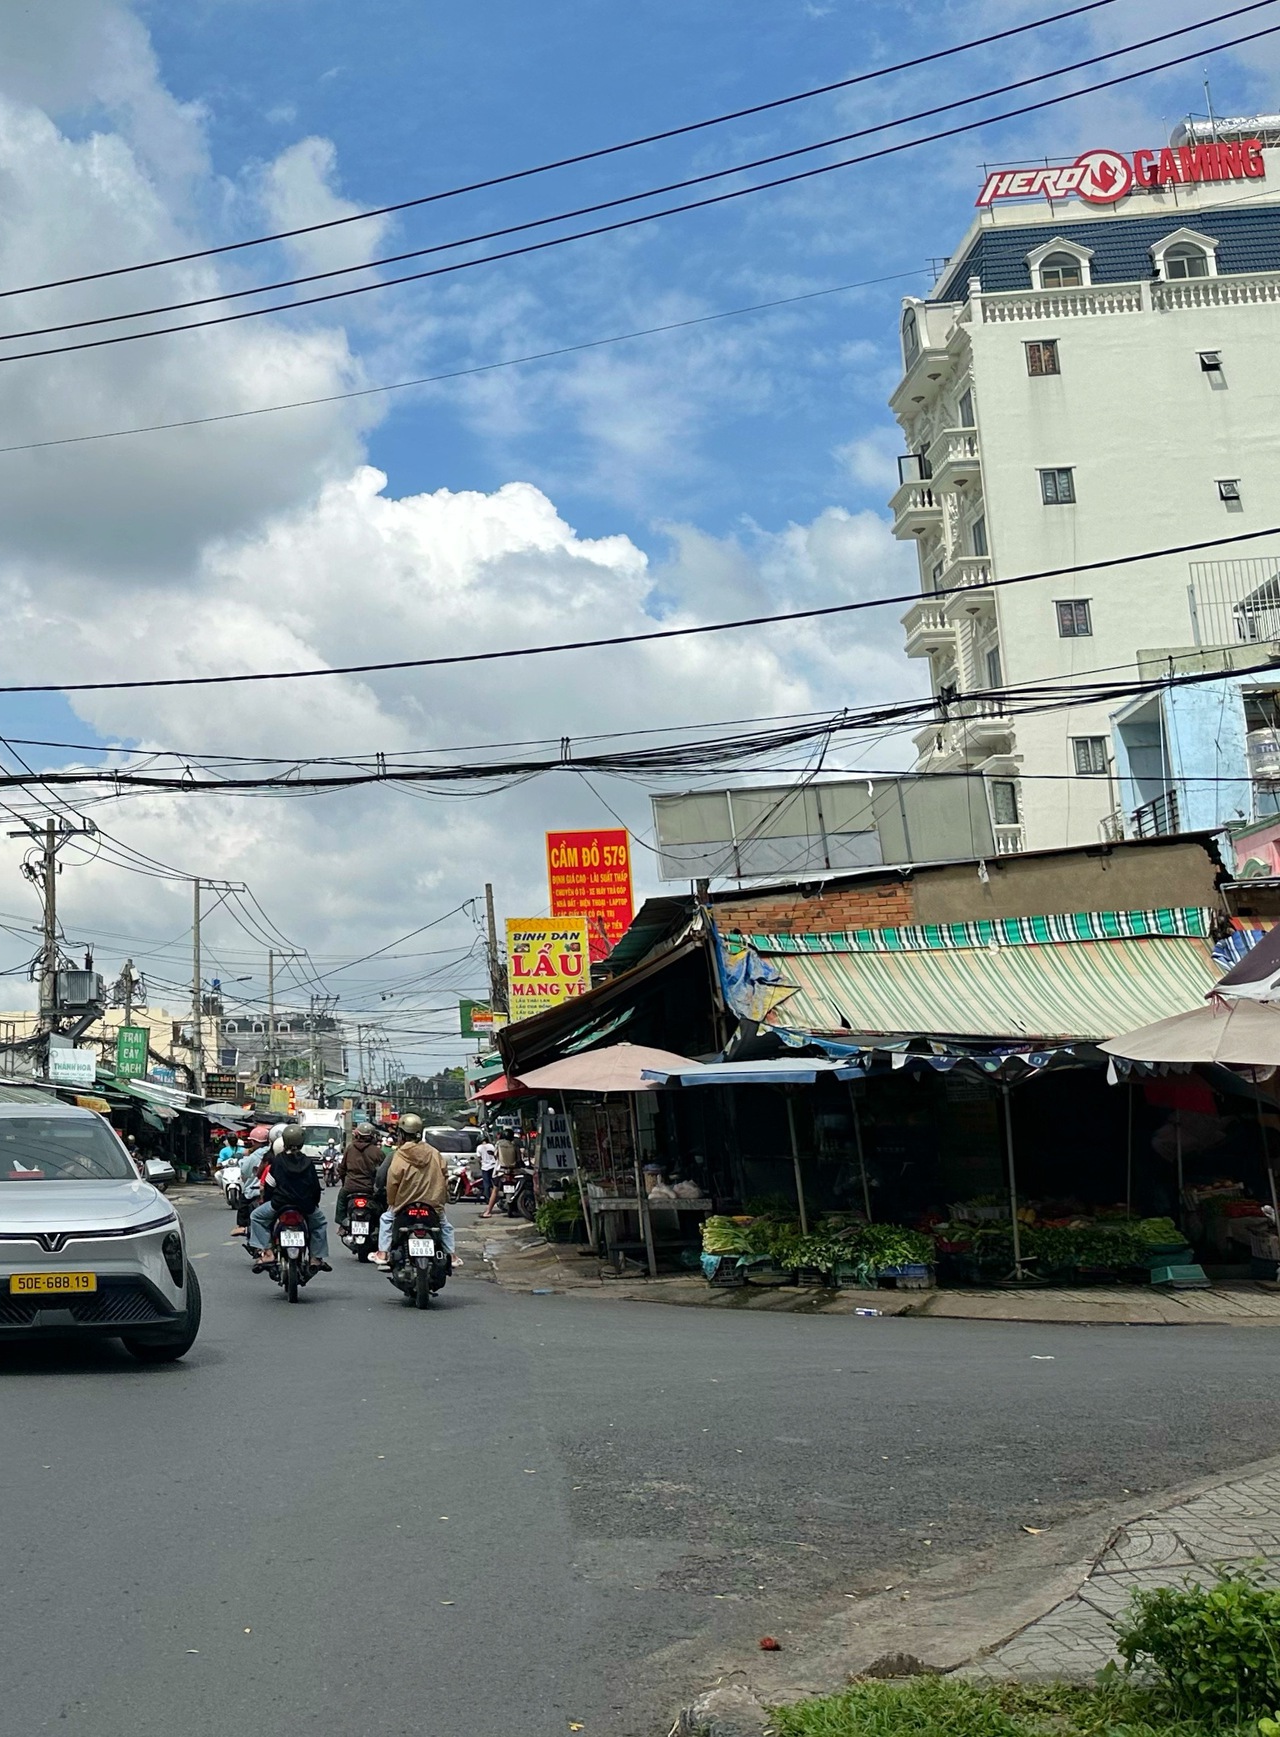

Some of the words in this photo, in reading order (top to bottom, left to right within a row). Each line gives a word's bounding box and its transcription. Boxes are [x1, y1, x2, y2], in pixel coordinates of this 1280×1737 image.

[978, 164, 1086, 206] HERO
[1133, 139, 1266, 188] GAMING
[550, 840, 579, 869] CẦM
[582, 838, 600, 867] ĐỒ
[603, 845, 626, 867] 579
[551, 930, 580, 941] DÂN
[511, 942, 584, 977] LẨU
[512, 983, 560, 996] MANG
[564, 976, 586, 996] VỀ
[546, 1135, 572, 1149] MANG
[17, 1276, 90, 1290] 50E-688.19
